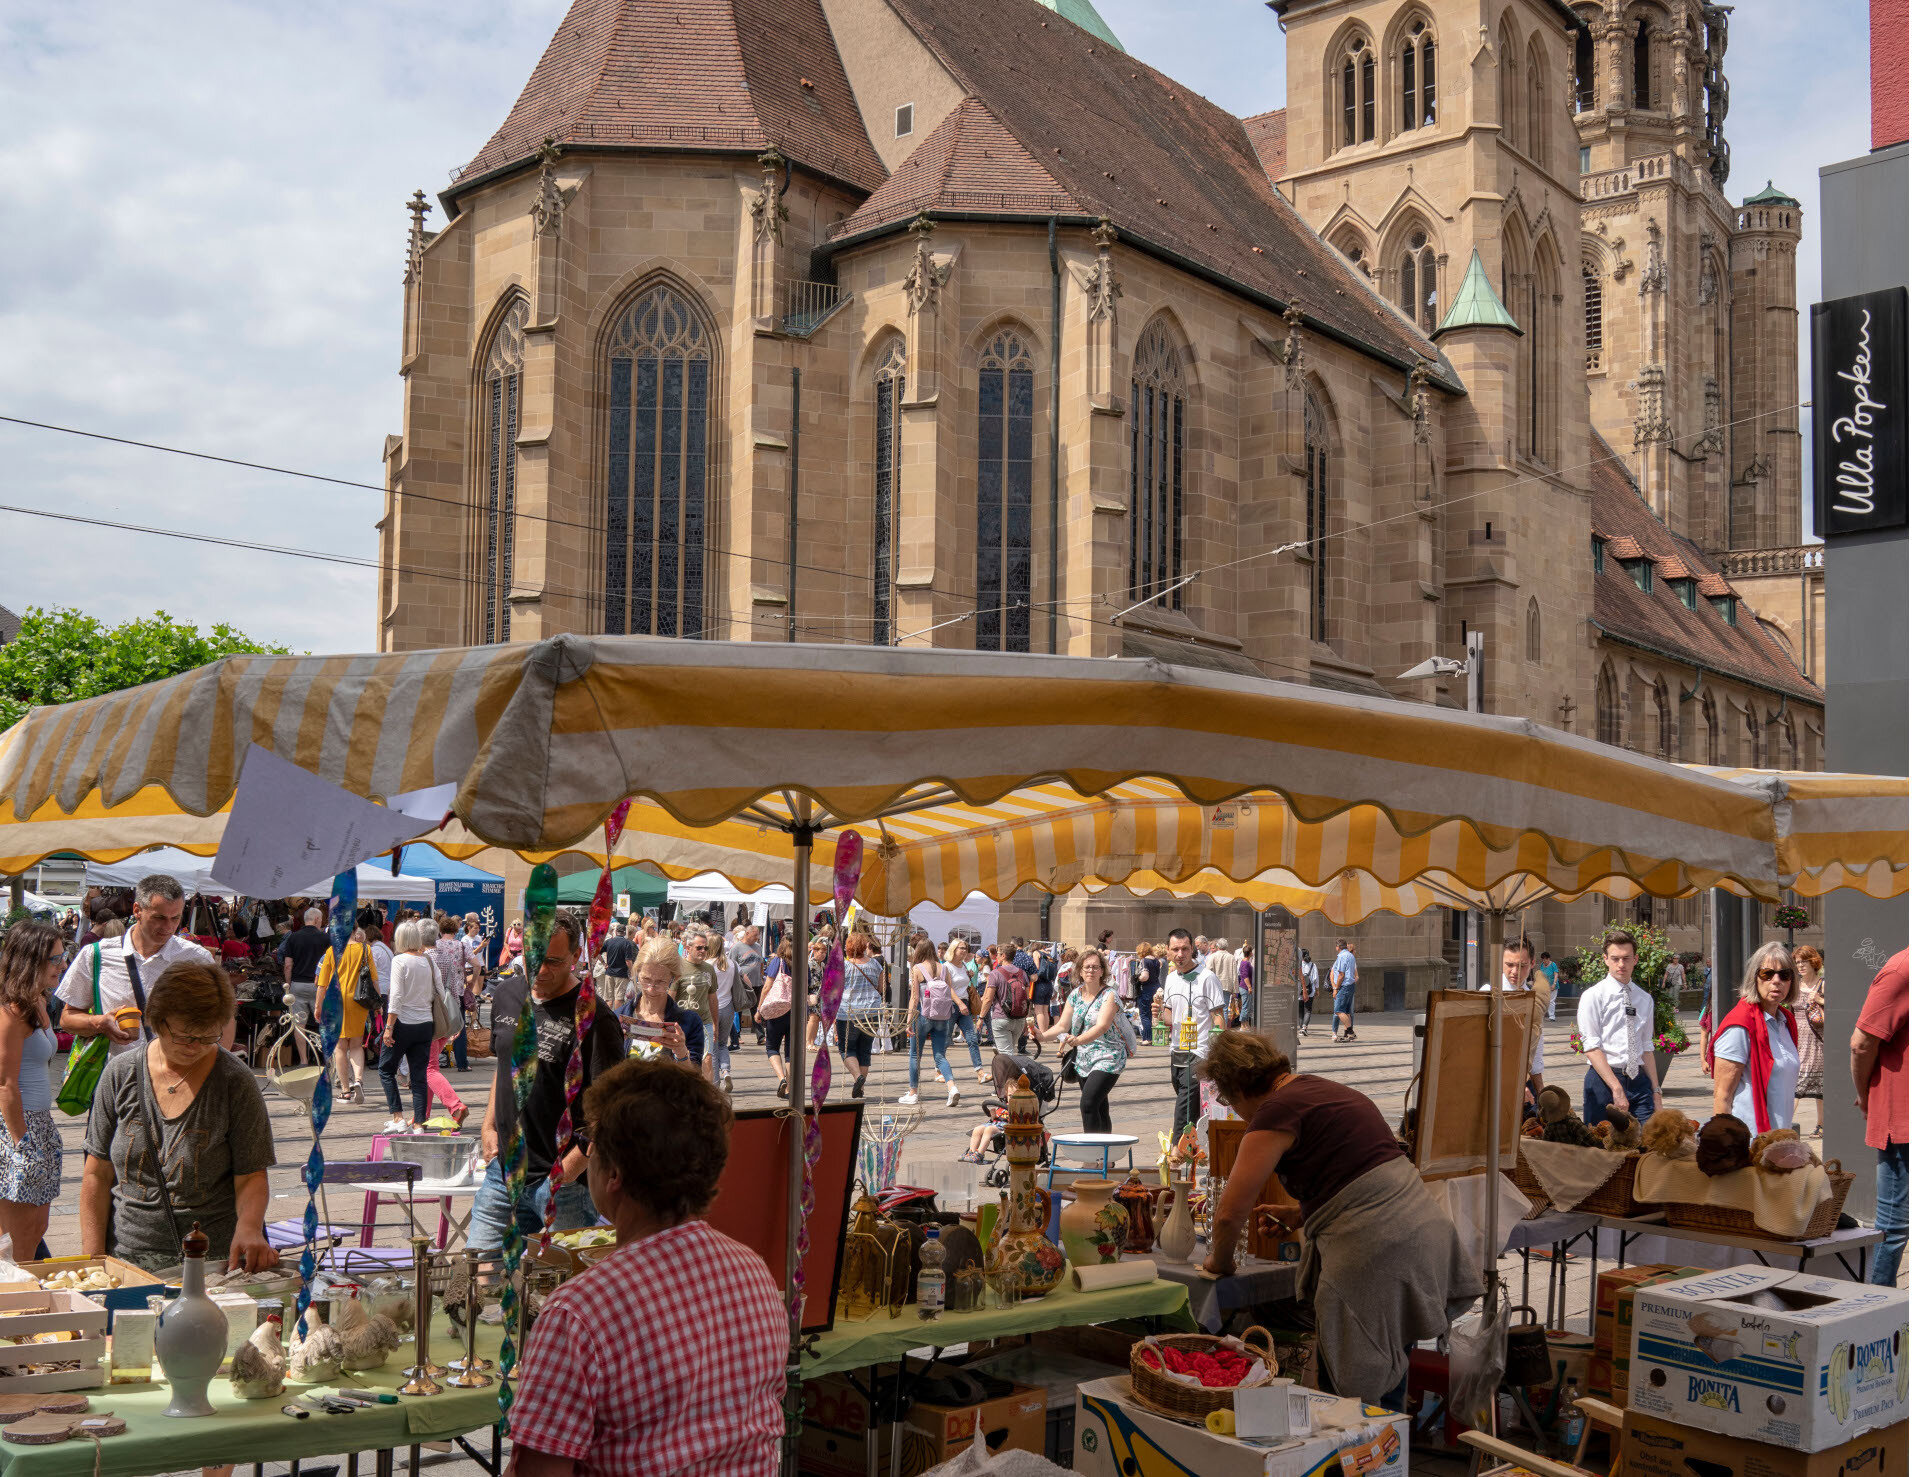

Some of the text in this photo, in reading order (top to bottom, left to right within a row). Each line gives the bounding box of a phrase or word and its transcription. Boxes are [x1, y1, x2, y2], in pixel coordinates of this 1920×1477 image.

[1832, 309, 1887, 514] Ulla Popken
[1666, 1272, 1768, 1297] BONITA
[1640, 1301, 1692, 1320] PREMIUM
[1856, 1337, 1894, 1384] BONITA
[803, 1381, 865, 1430] Dole
[1687, 1375, 1742, 1414] BONITA
[1853, 1399, 1895, 1421] PREMIUM PACK
[1640, 1450, 1657, 1463] Obst
